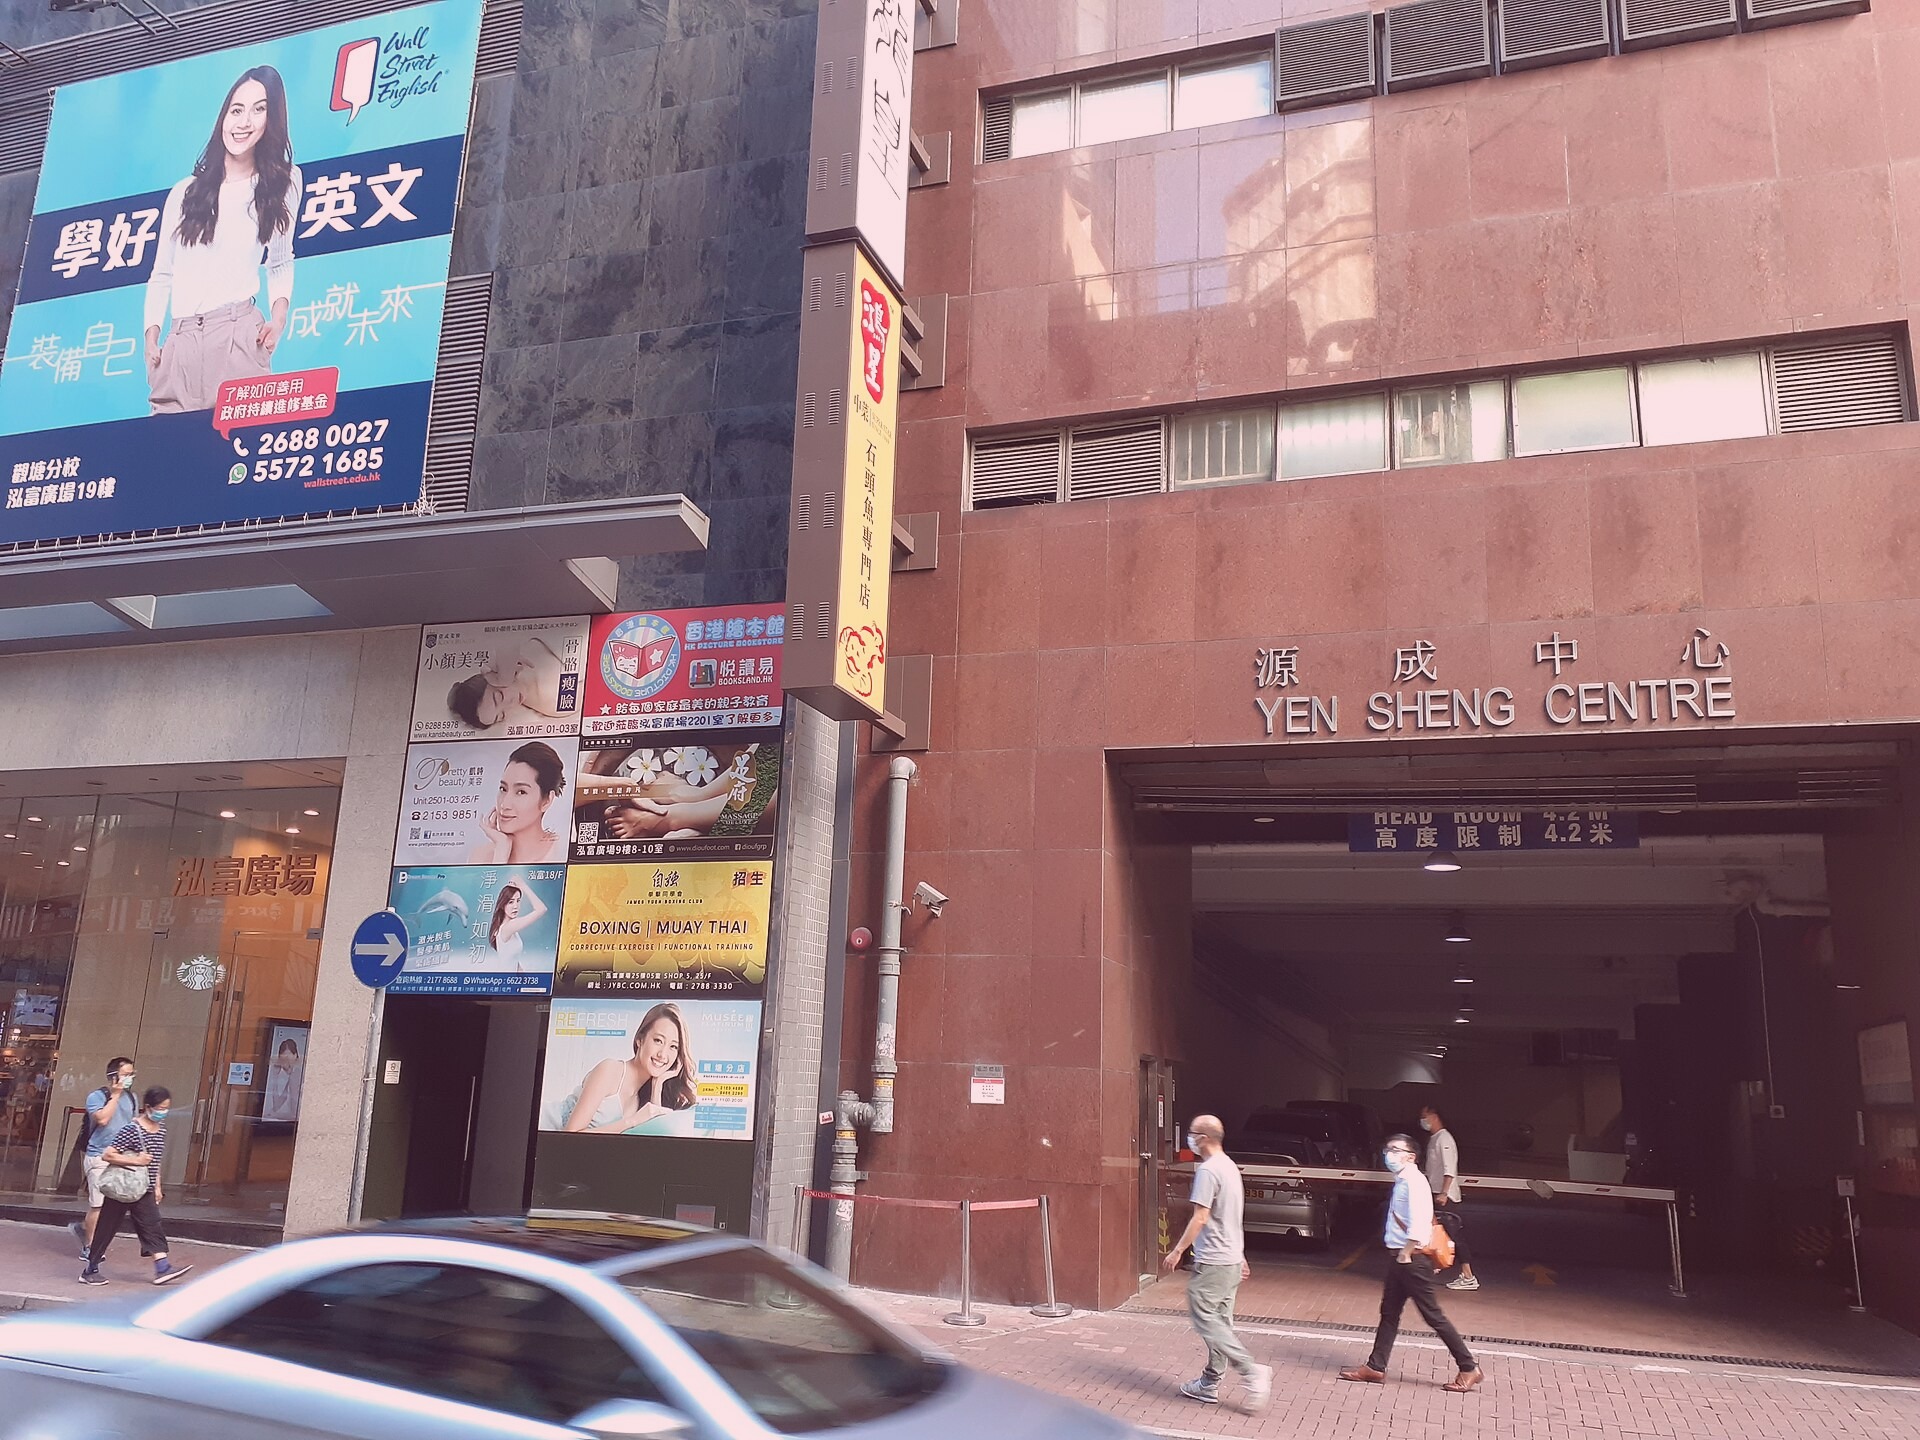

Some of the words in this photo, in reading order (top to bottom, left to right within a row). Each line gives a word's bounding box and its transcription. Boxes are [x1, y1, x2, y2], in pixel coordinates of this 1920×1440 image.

[383, 26, 430, 54] Wall
[380, 53, 440, 79] Street
[378, 71, 442, 108] English
[51, 207, 160, 280] 學好
[298, 162, 424, 241] 英文
[28, 320, 137, 384] 裝備自己
[287, 282, 416, 347] 成就未來
[223, 377, 305, 404] 了解如何善用
[219, 392, 329, 422] 政府持續進修基金
[257, 426, 320, 456] 2688
[325, 418, 390, 448] 0027
[11, 456, 82, 485] 觀塘分校
[253, 454, 315, 484] 5572
[322, 446, 384, 475] 1685
[5, 476, 117, 510] 泓富廣場19樓
[303, 471, 382, 490] wallstreet.edu.hk
[858, 438, 877, 610] 石頭魚專門店
[685, 615, 785, 642] 香港繪本館
[697, 640, 735, 649] PICTURE
[1254, 627, 1731, 688] 源成中心
[718, 675, 773, 686] BOOKSLAND.HK
[615, 695, 770, 715] 給每個家庭最美的親子教育
[1255, 694, 1339, 735] YEN
[1366, 686, 1516, 731] SHENG
[1545, 676, 1737, 725] CENTRE
[438, 777, 467, 788] beauty
[422, 810, 448, 820] 2153
[452, 810, 478, 820] 9851
[1375, 824, 1523, 849] 高度限制
[173, 853, 319, 898] 泓富廣場
[527, 870, 564, 880] 泓富18/F
[733, 870, 764, 887] 招生
[579, 920, 641, 935] BOXING
[656, 920, 703, 935] MUAY
[709, 920, 748, 934] THAI
[570, 943, 615, 951] CORRECTIVE
[619, 943, 655, 951] EXERCISE
[664, 943, 712, 951] FUNCTIONAL
[690, 982, 710, 990] 2788
[713, 982, 733, 990] 3330
[555, 1011, 629, 1029] REFRESH
